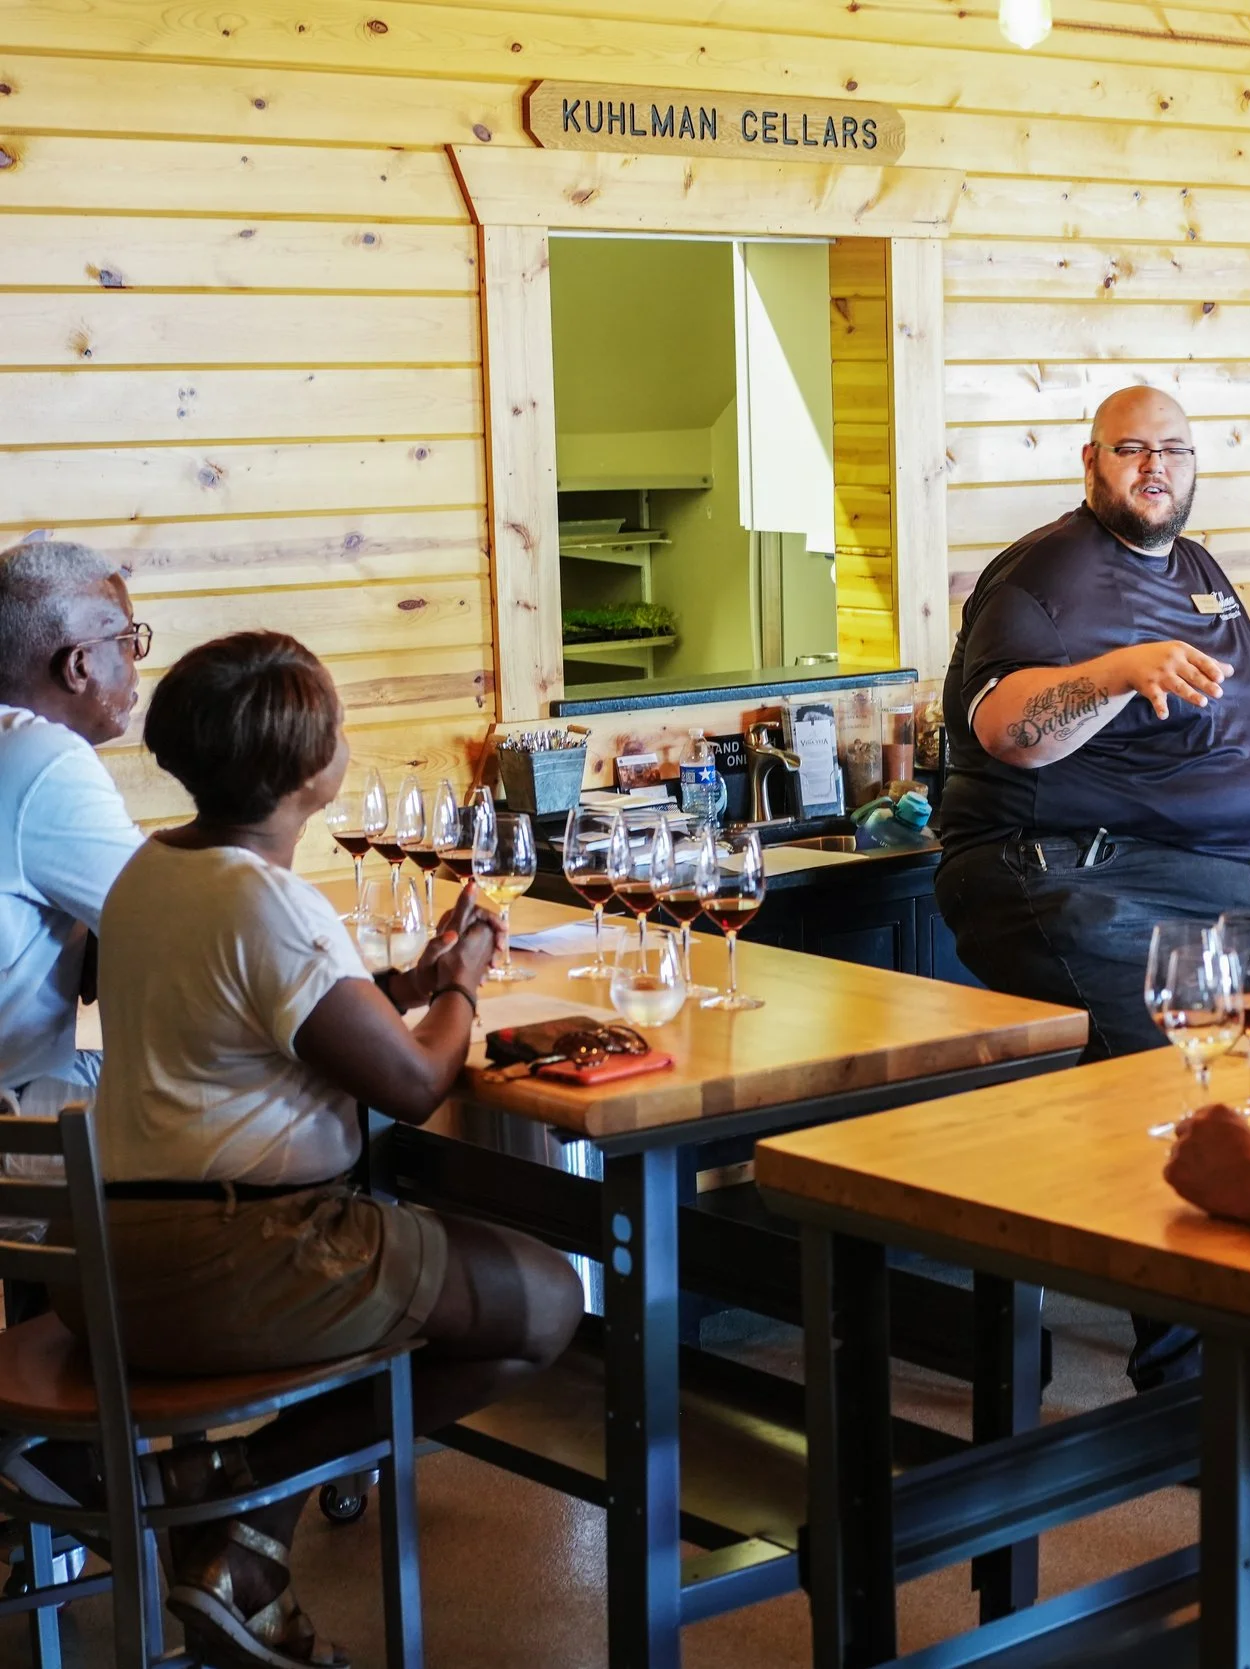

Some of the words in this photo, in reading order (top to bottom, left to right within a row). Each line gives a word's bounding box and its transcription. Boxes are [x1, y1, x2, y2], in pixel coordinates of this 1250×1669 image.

[562, 98, 718, 141] KUHLMAN
[741, 109, 878, 150] CELLARS
[714, 740, 740, 754] AND
